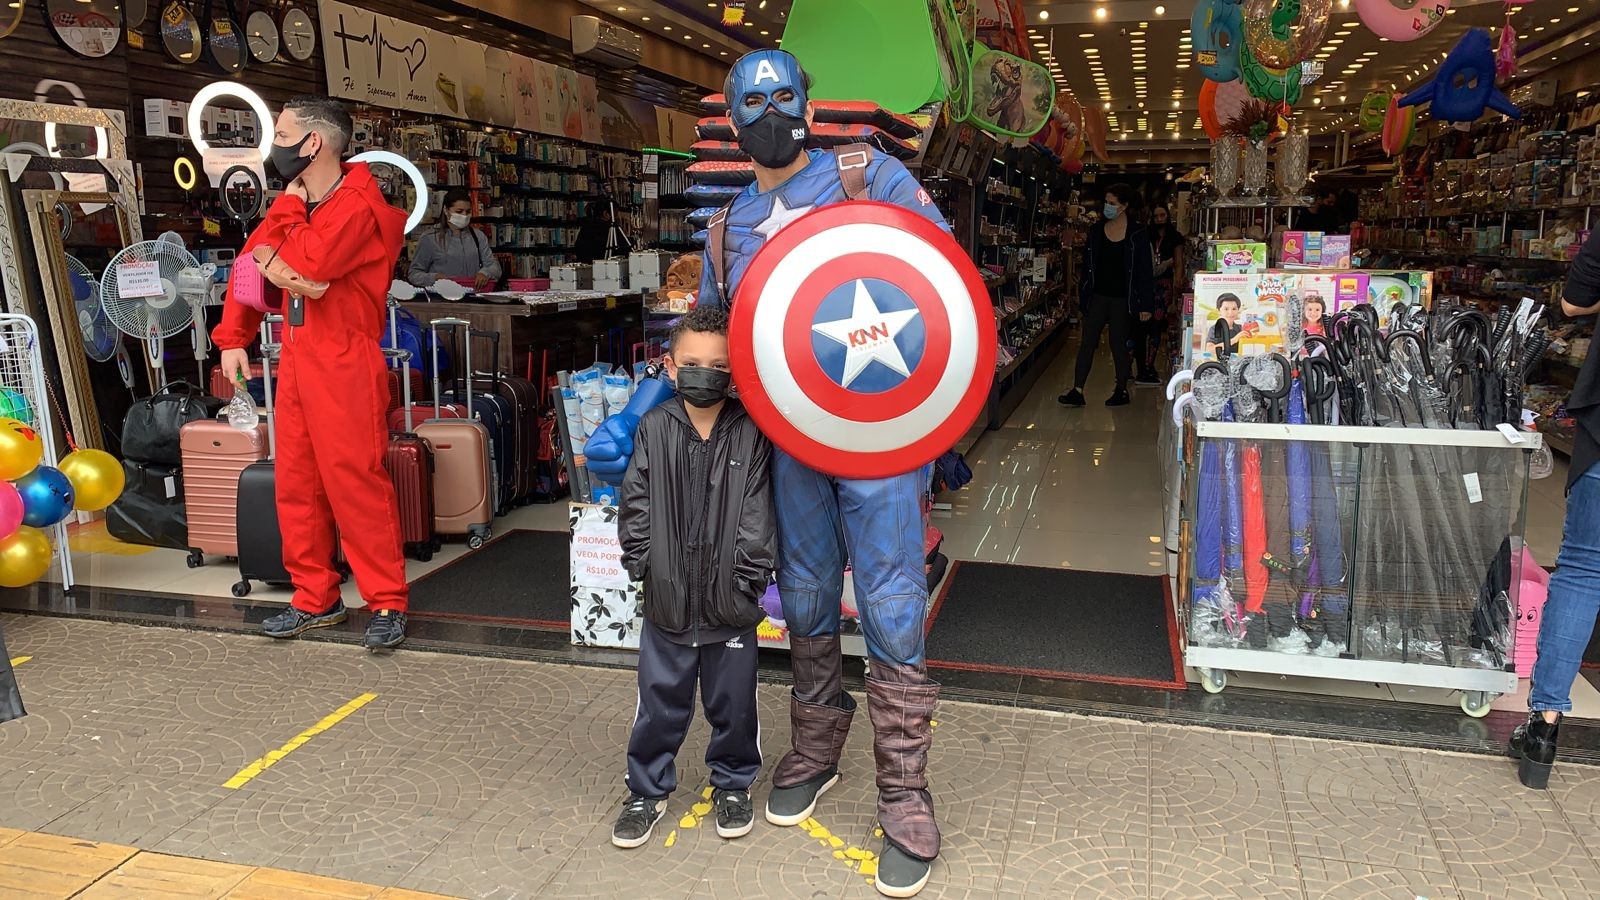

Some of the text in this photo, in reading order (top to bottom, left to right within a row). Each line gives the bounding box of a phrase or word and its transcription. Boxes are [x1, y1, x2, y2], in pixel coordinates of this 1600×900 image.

[753, 59, 780, 86] A
[343, 76, 355, 91] Fé
[366, 83, 396, 99] Esperança
[406, 89, 427, 103] Amor
[791, 127, 805, 138] KNN
[848, 322, 889, 347] KNN
[577, 536, 620, 546] PROMOÇA
[575, 550, 622, 561] VEDA PORT
[585, 566, 619, 577] R$10,00
